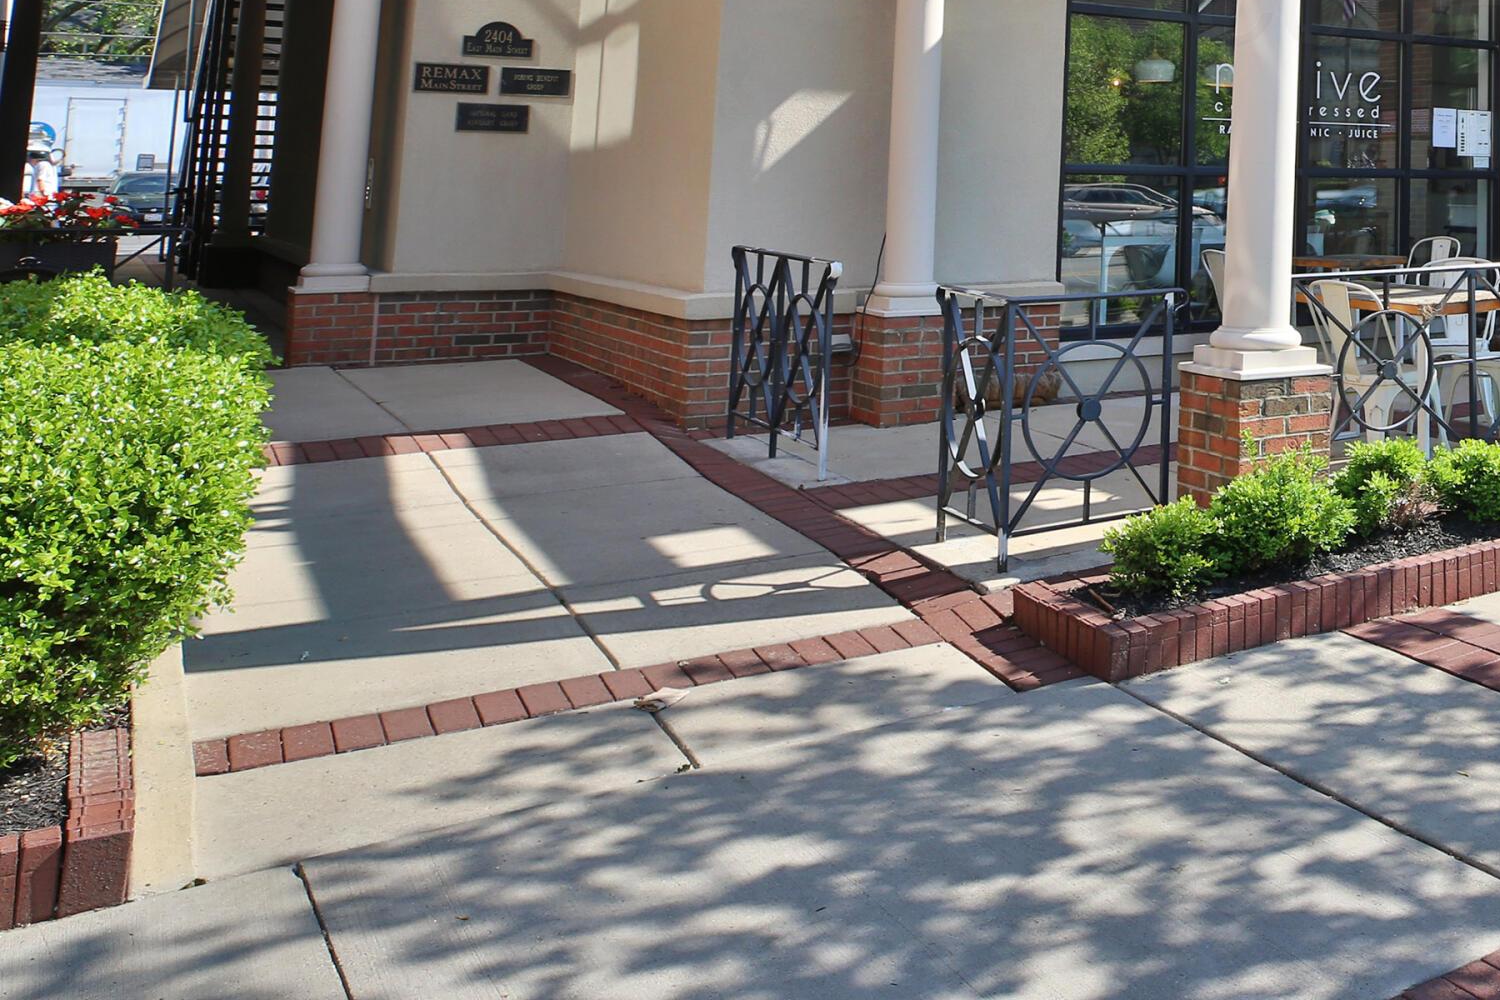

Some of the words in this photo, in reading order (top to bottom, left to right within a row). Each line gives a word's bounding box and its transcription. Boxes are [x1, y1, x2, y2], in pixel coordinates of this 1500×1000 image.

[484, 28, 513, 44] 2404
[422, 65, 481, 80] REMAX
[1348, 129, 1379, 139] JUICE
